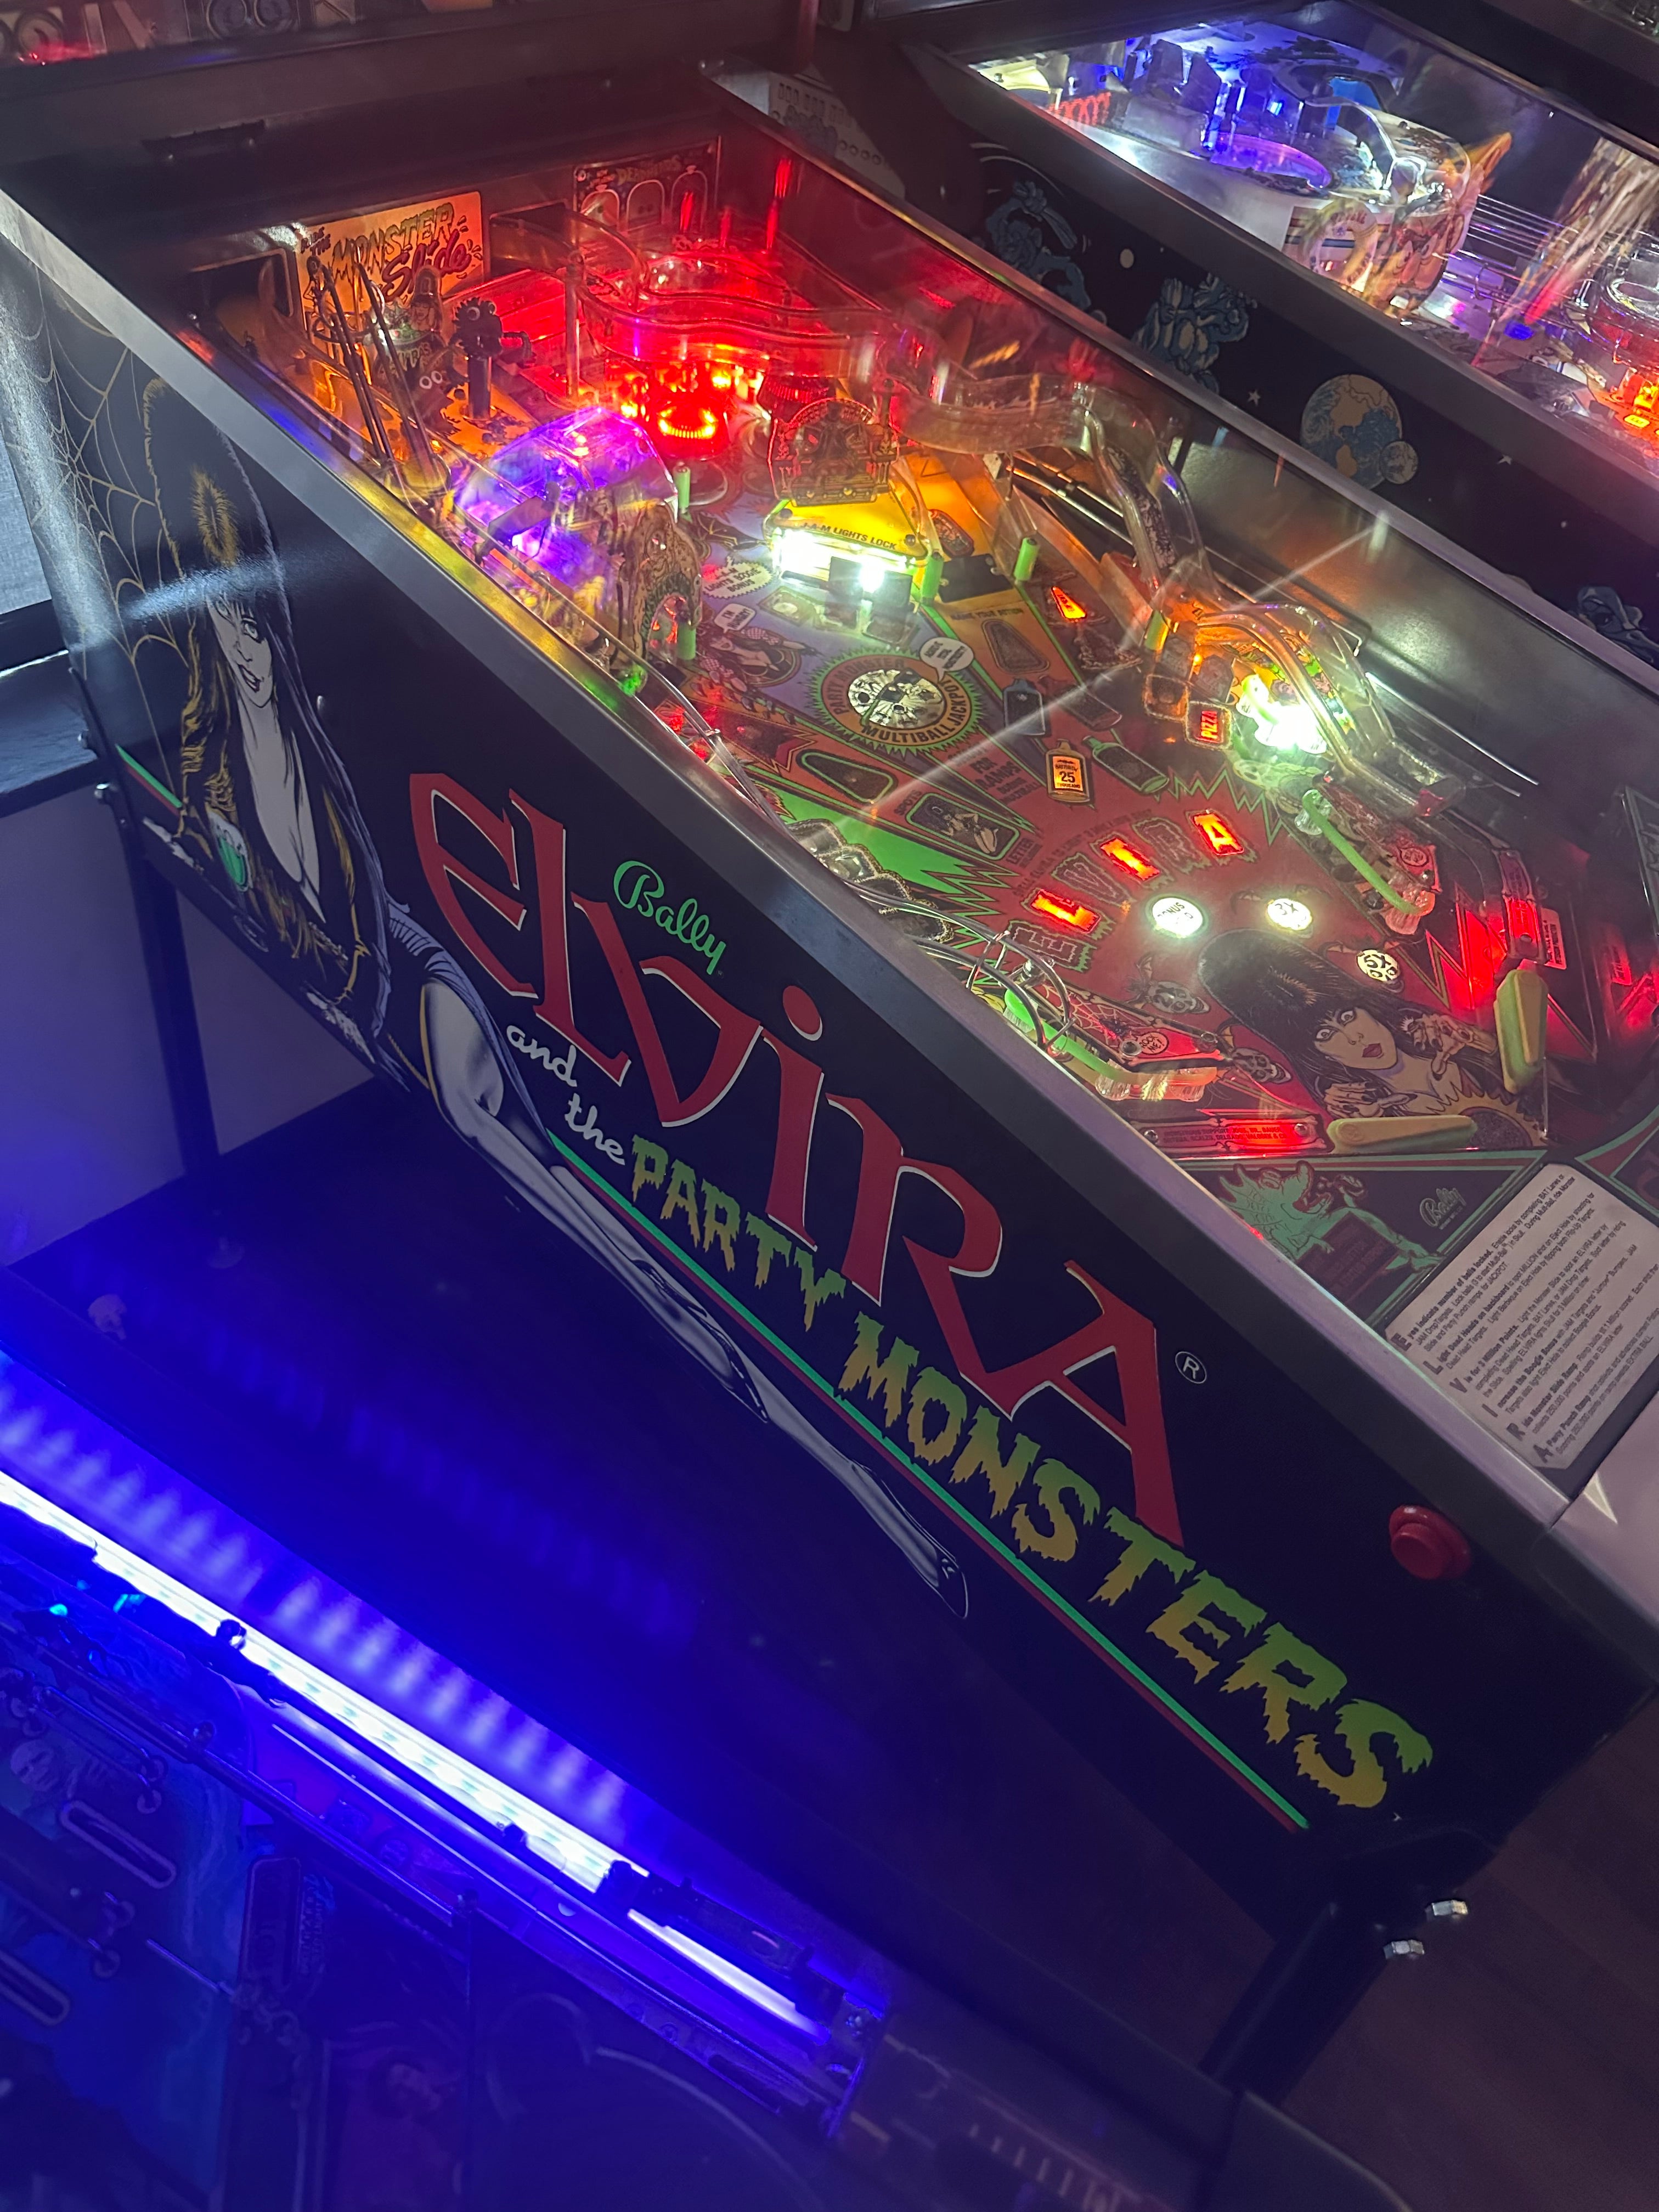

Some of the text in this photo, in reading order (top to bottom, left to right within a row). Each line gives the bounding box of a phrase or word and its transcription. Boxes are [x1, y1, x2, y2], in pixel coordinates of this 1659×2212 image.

[329, 202, 455, 285] MONSTER
[382, 228, 472, 302] Slide
[832, 527, 868, 543] LIGHTS
[870, 536, 897, 550] LOCK
[704, 567, 762, 592] LIGHTS BOOGIE
[727, 579, 755, 592] BONUS
[827, 681, 850, 715] PARTY
[861, 679, 968, 744] MULTIBALL JACKPOT
[1200, 710, 1218, 740] PIZZA
[970, 757, 997, 772] FOR
[975, 760, 1020, 789] RAMPS
[1059, 771, 1076, 784] 25
[894, 789, 922, 816] SPOTS
[1006, 837, 1033, 865] LETTER
[613, 860, 727, 975] Bally
[1274, 901, 1299, 916] 3X
[1362, 951, 1395, 970] 5X
[1419, 1187, 1468, 1229] Bally
[1415, 1304, 1440, 1328] indicate
[1435, 1284, 1459, 1307] number
[1460, 1265, 1477, 1281] balls
[1537, 1188, 1550, 1200] BAT
[1447, 1334, 1464, 1351] Dead
[1459, 1317, 1480, 1337] Heads
[1482, 1284, 1511, 1312] backboard
[1469, 1364, 1481, 1376] for
[1481, 1341, 1502, 1363] Million
[1575, 1238, 1594, 1257] ELVIRA
[1434, 1328, 1446, 1340] and
[1514, 1373, 1527, 1385] the
[1523, 1353, 1545, 1376] Boogie
[1540, 1336, 1558, 1356] Bonus
[506, 1025, 1434, 1809] and the PARTY MONSTERS
[1528, 1391, 1554, 1418] Monster
